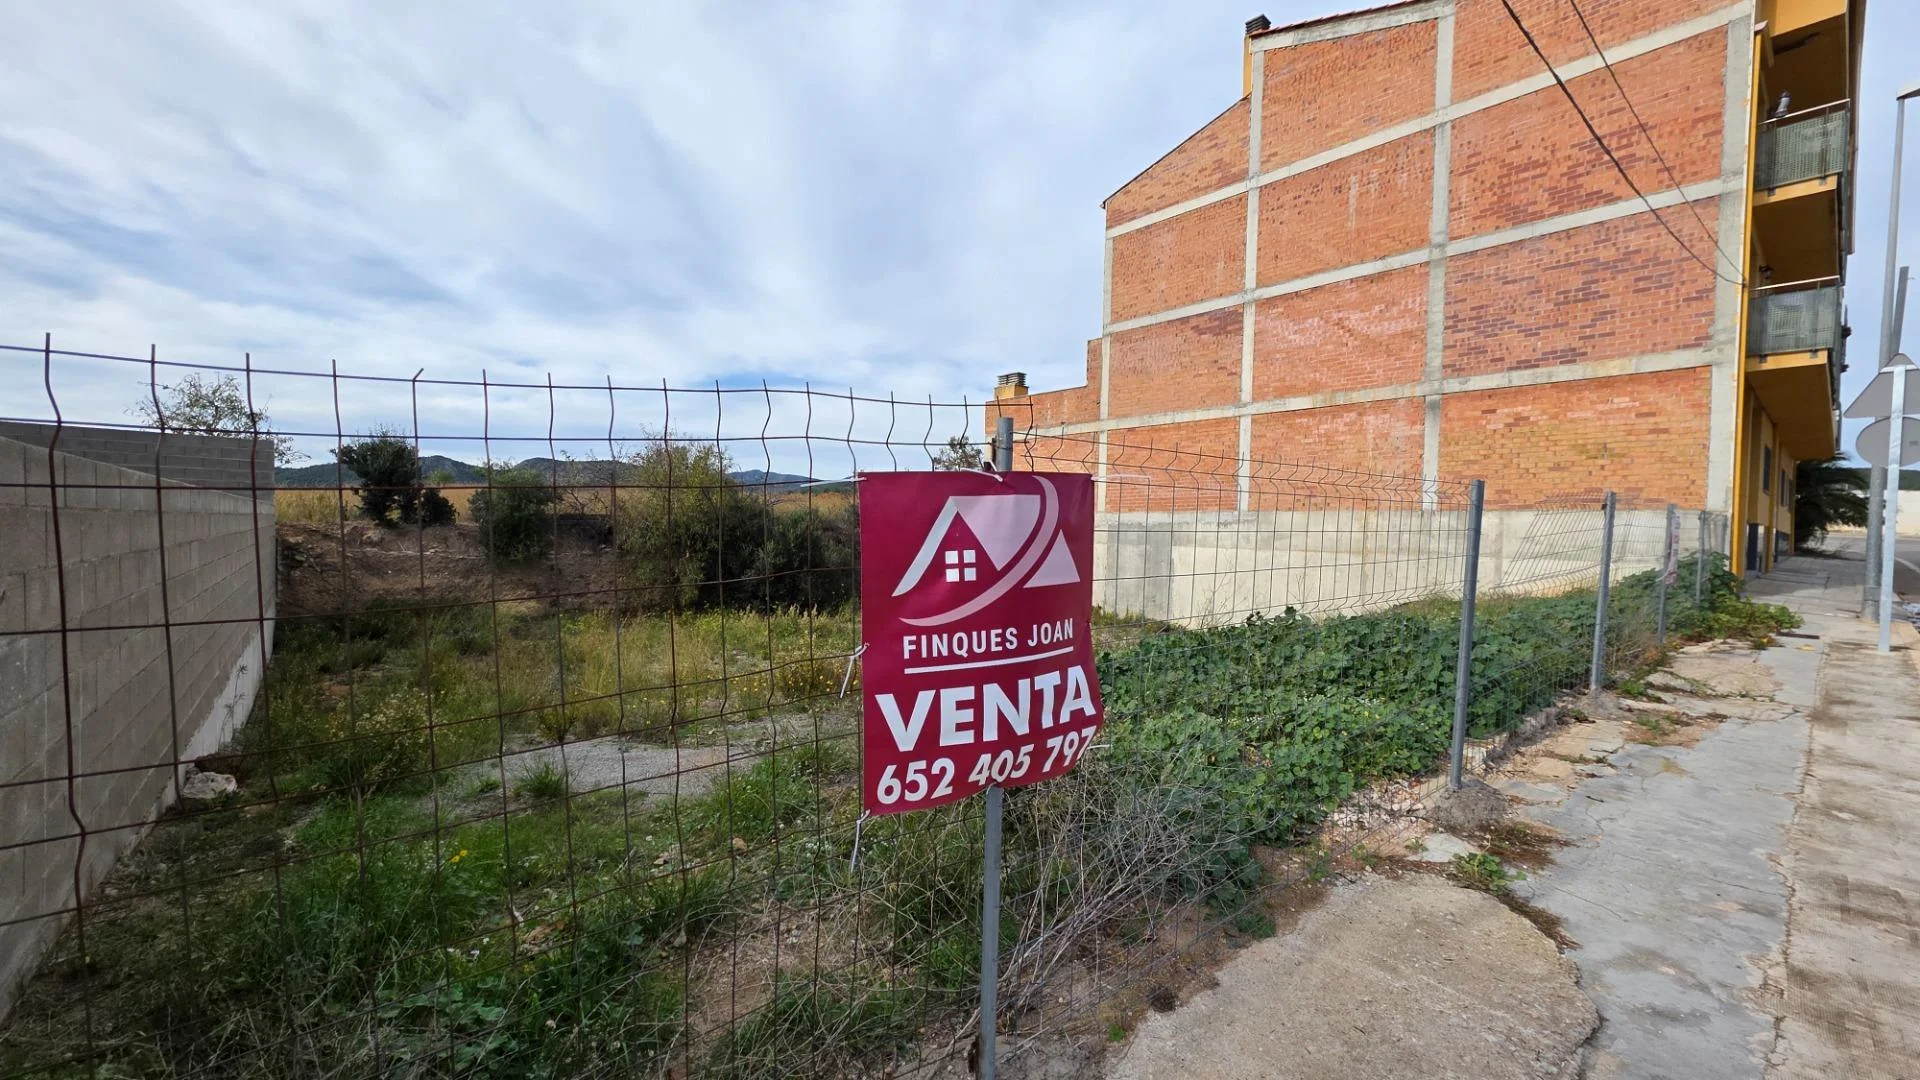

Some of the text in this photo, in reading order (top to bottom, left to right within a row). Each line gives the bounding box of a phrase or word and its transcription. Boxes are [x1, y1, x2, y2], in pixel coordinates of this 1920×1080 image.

[903, 618, 1073, 659] FINQUES JOAN
[875, 665, 1096, 752] VENTA
[877, 725, 1097, 804] 652 405 797
